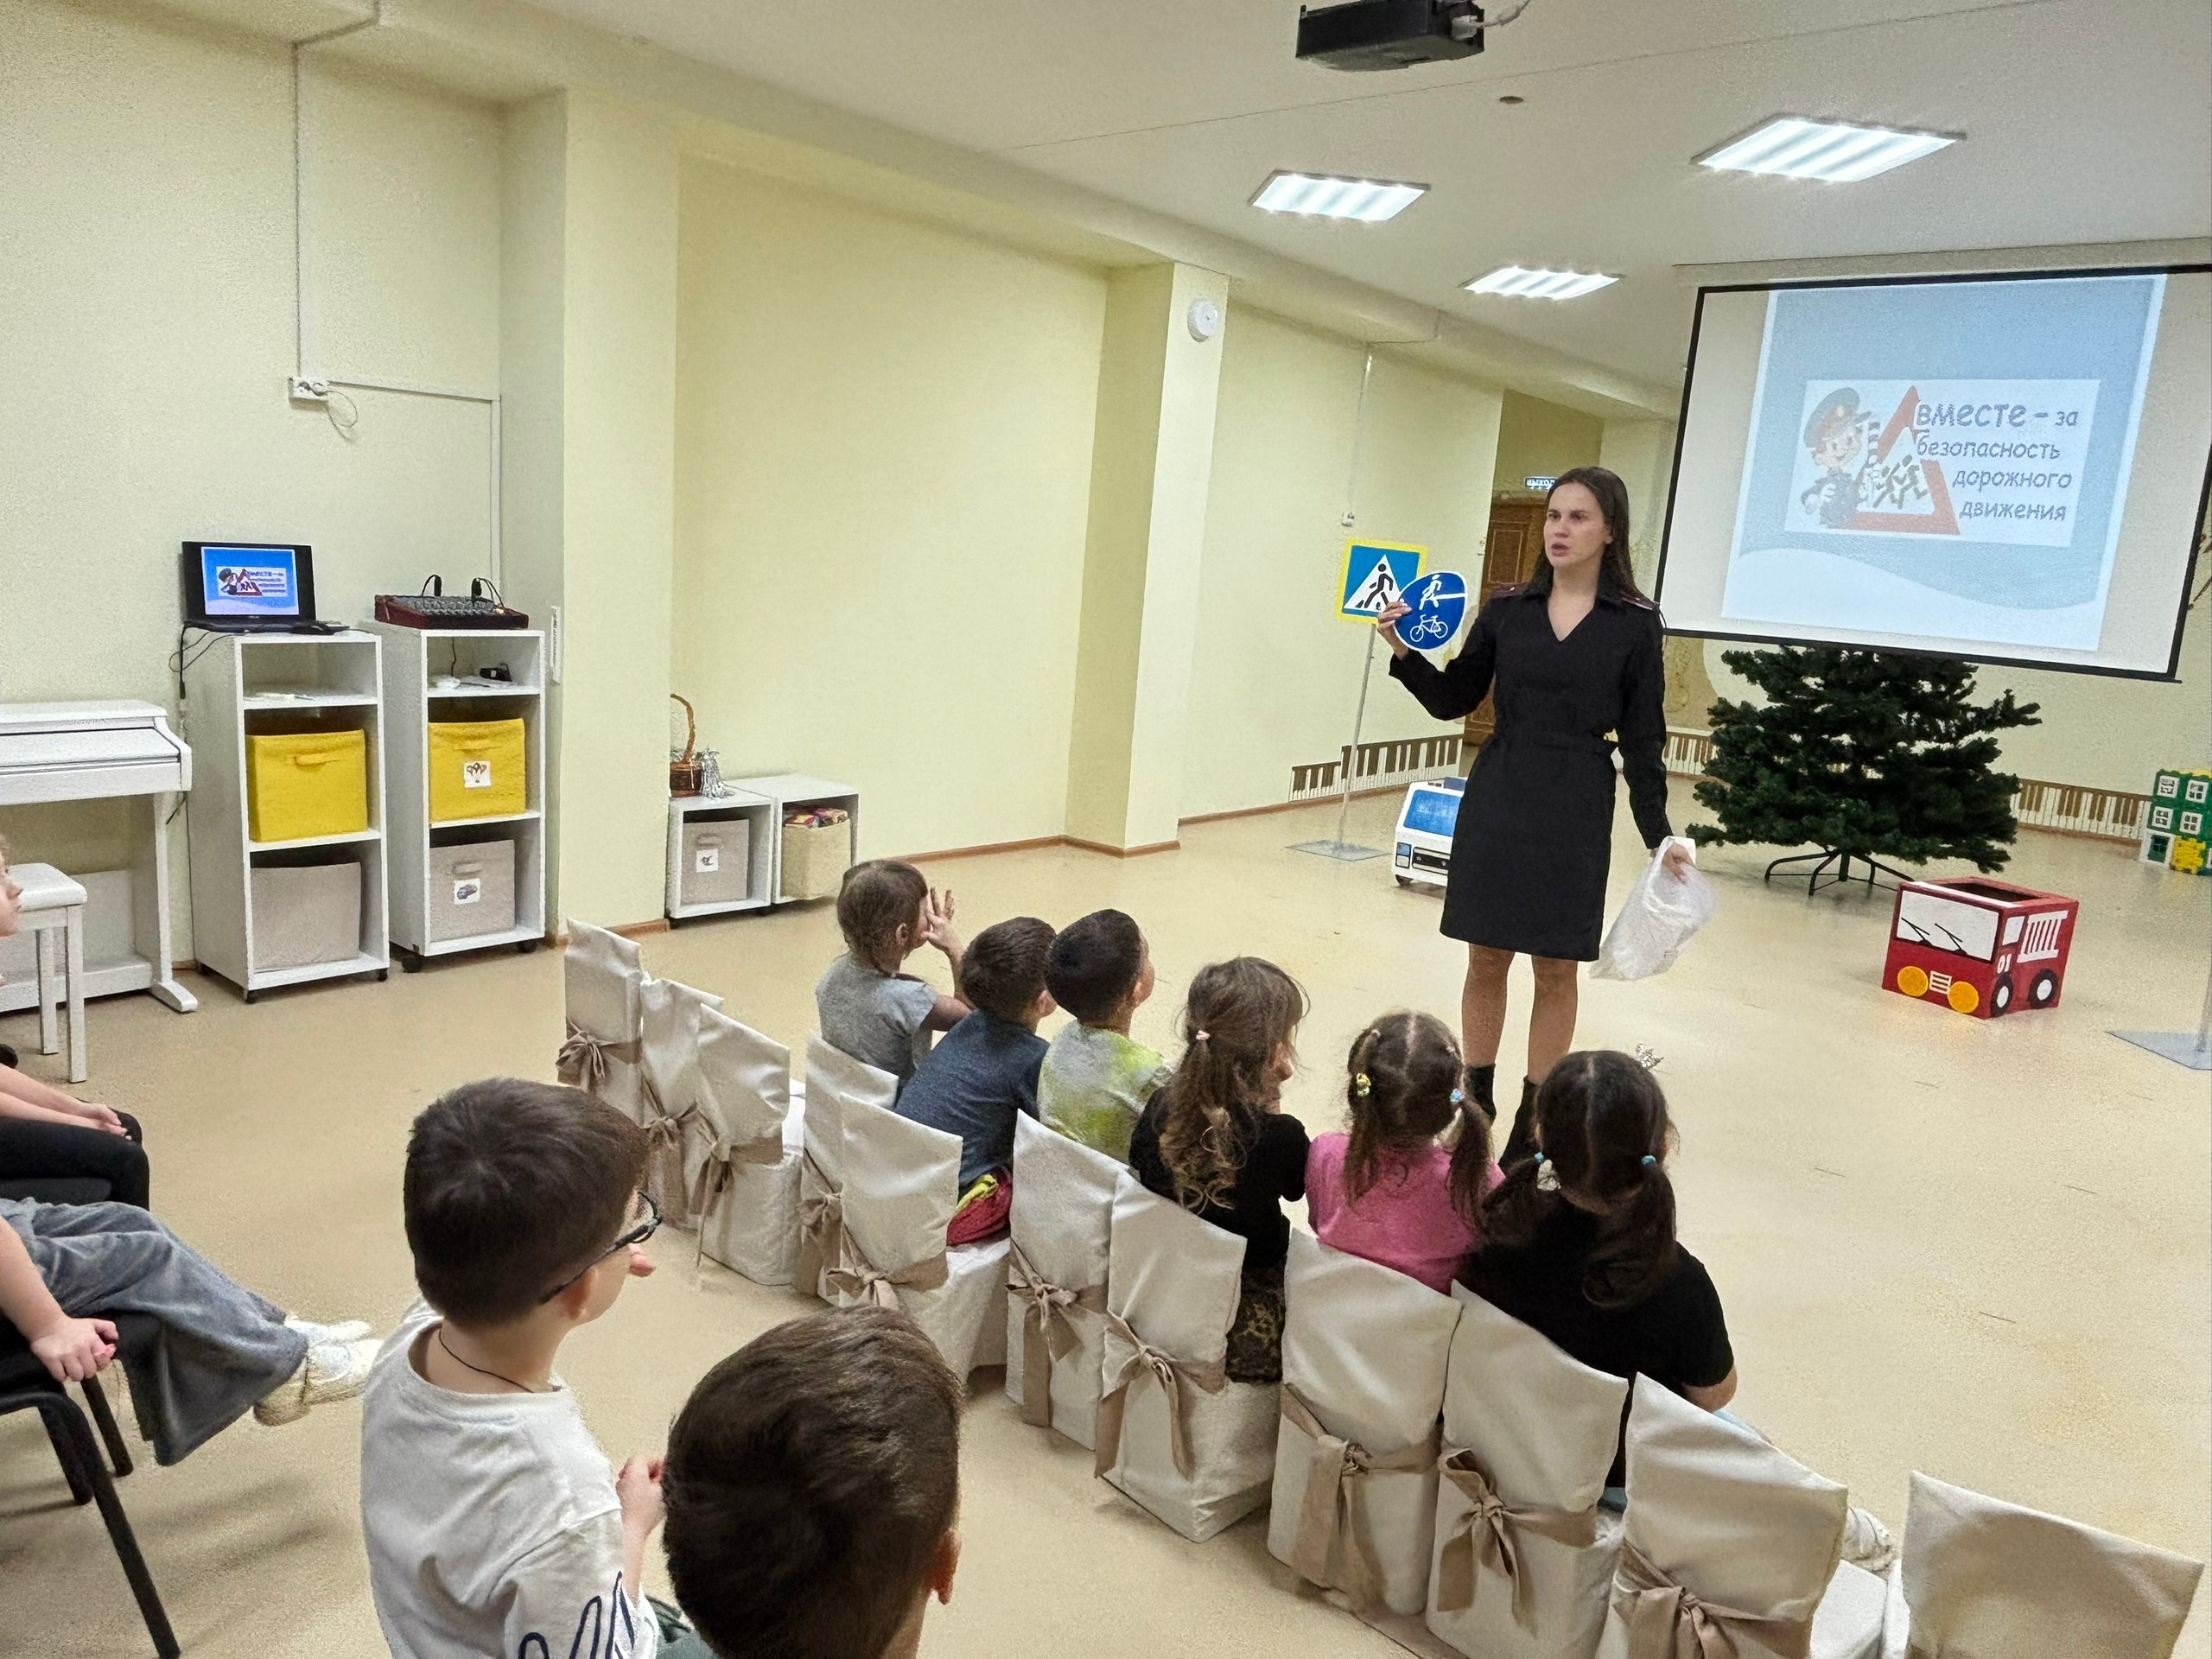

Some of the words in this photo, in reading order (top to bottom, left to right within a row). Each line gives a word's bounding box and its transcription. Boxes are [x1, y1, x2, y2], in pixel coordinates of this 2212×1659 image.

[2054, 410, 2080, 427] за
[1916, 435, 2061, 459] безопасность
[1951, 469, 2073, 493] дорожного
[1958, 500, 2067, 521] движения
[1997, 953, 2012, 974] 01
